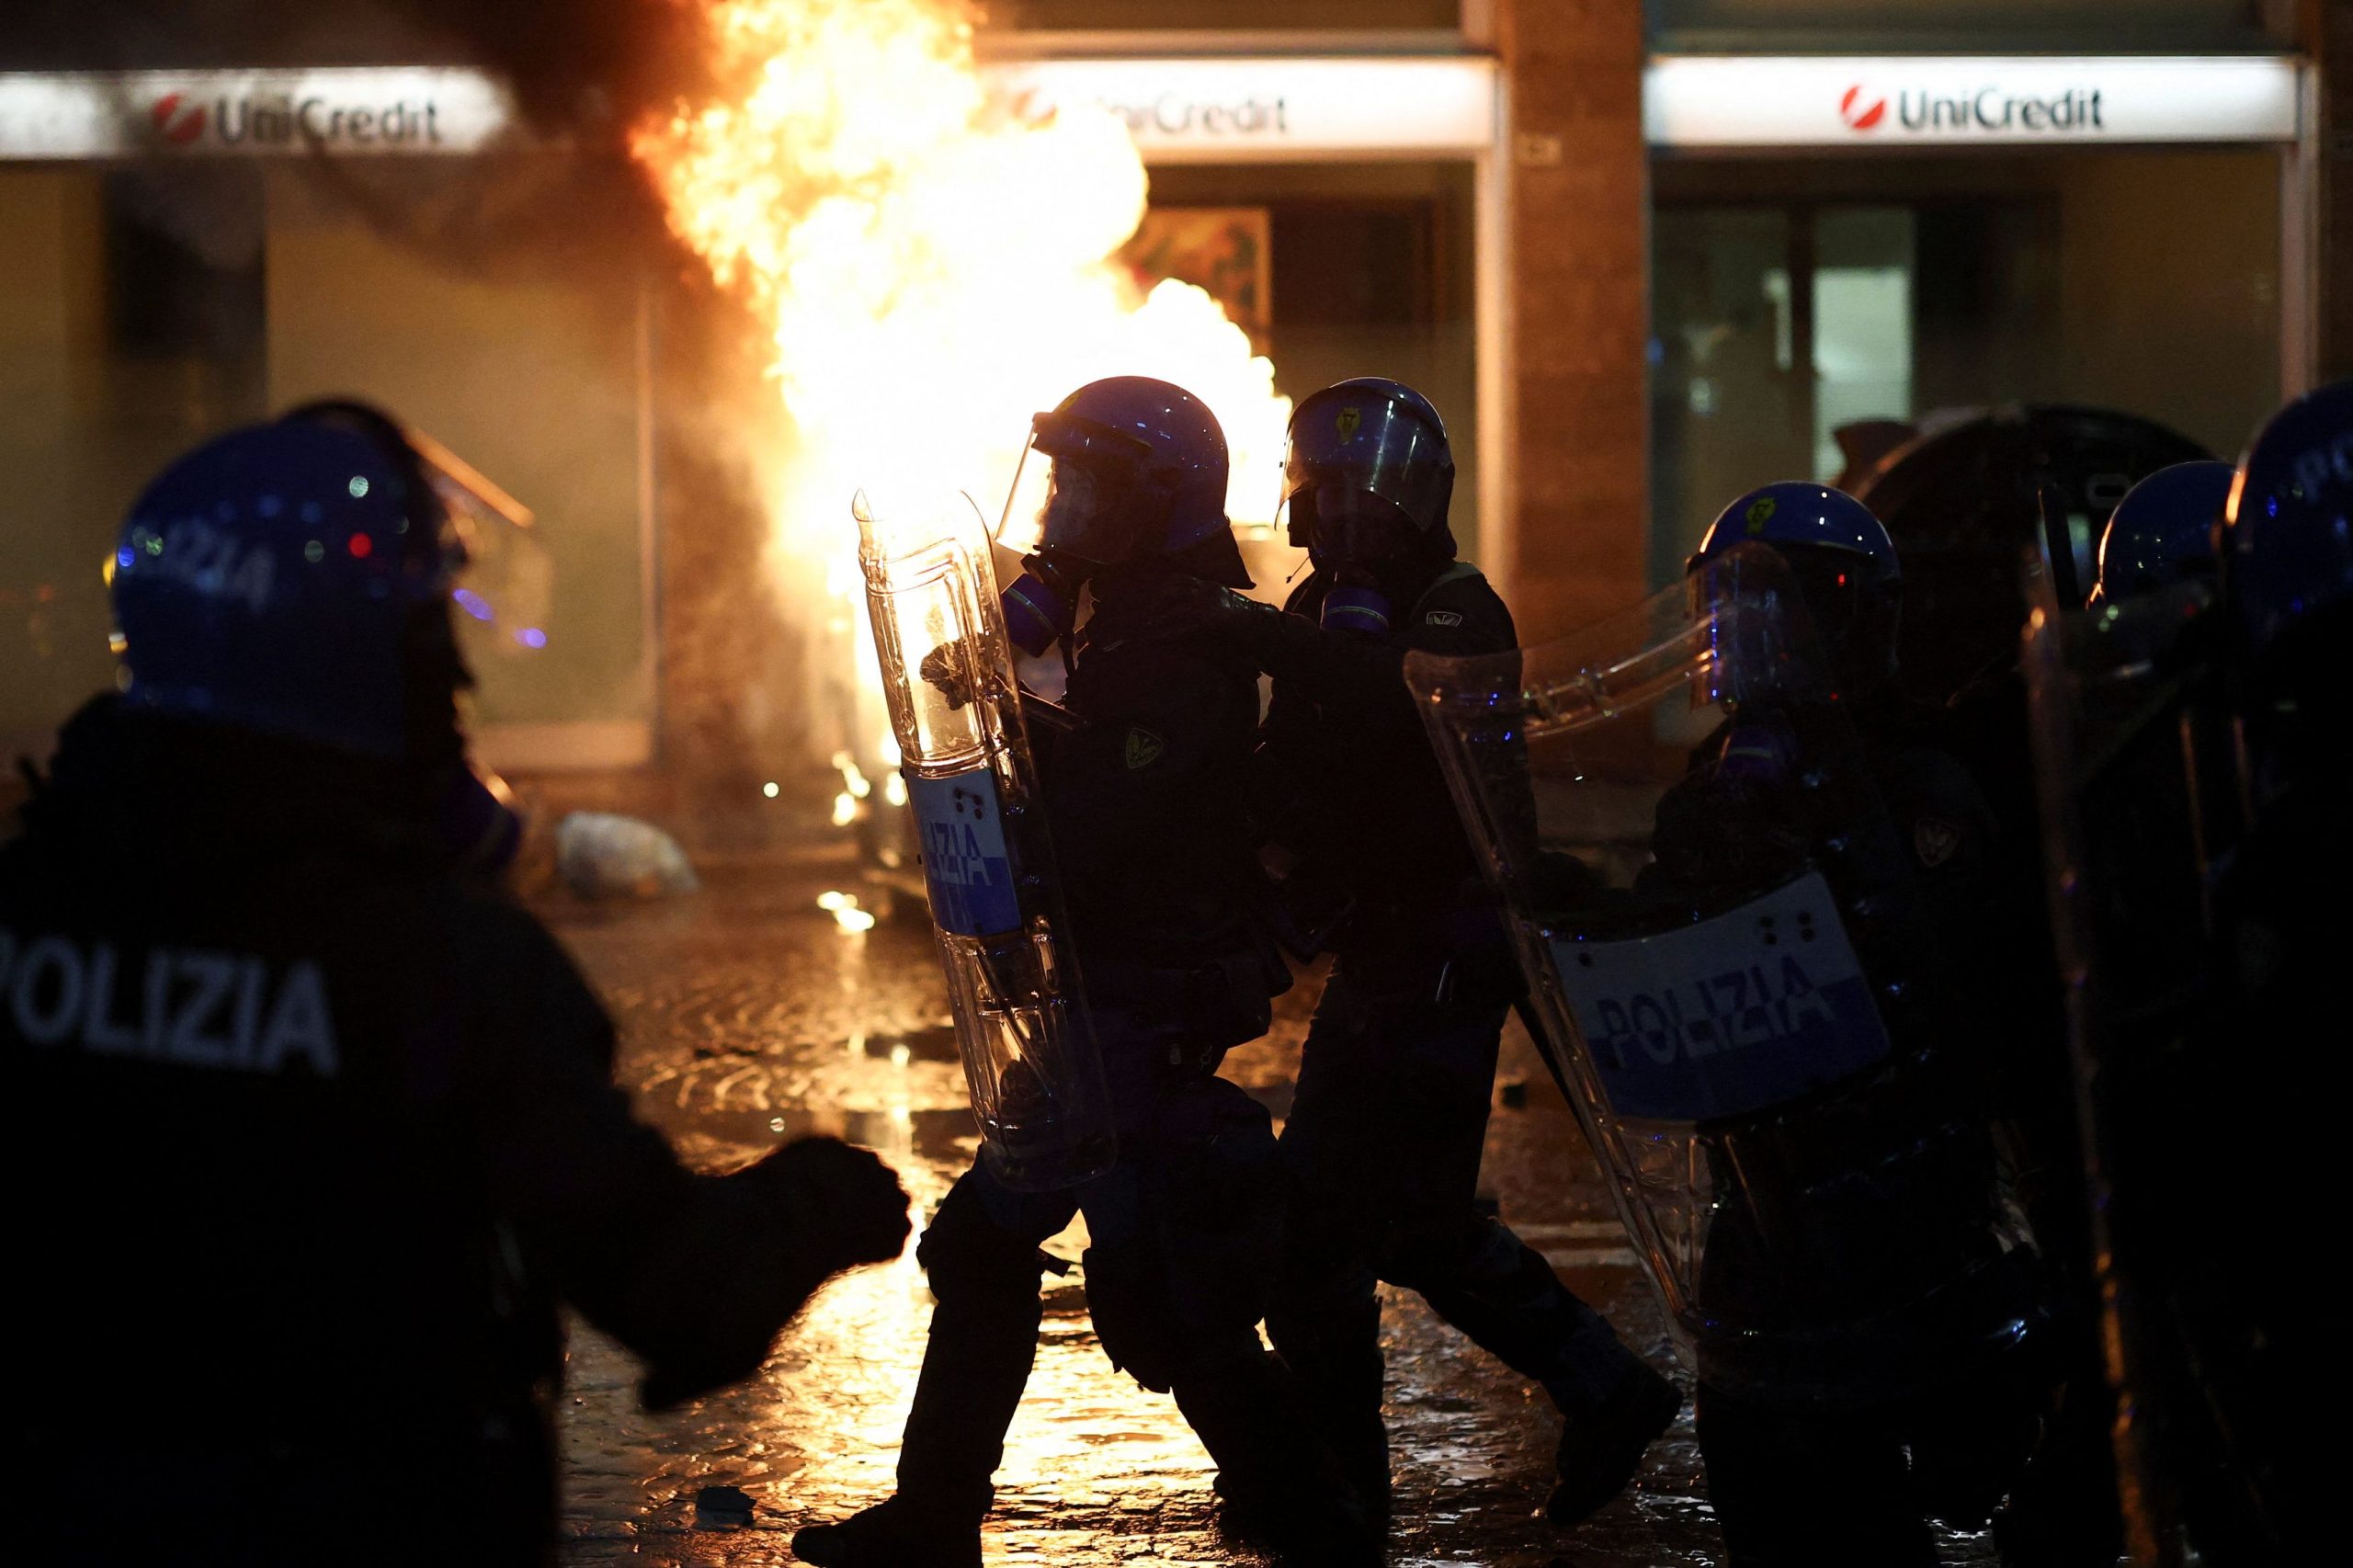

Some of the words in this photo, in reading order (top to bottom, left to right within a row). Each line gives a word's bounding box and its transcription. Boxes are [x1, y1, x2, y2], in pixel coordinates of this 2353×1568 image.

[216, 95, 439, 143] UniCredit
[1094, 92, 1288, 135] niCredit
[1899, 87, 2104, 131] UniCredit
[1597, 955, 1837, 1069] POLIZIA
